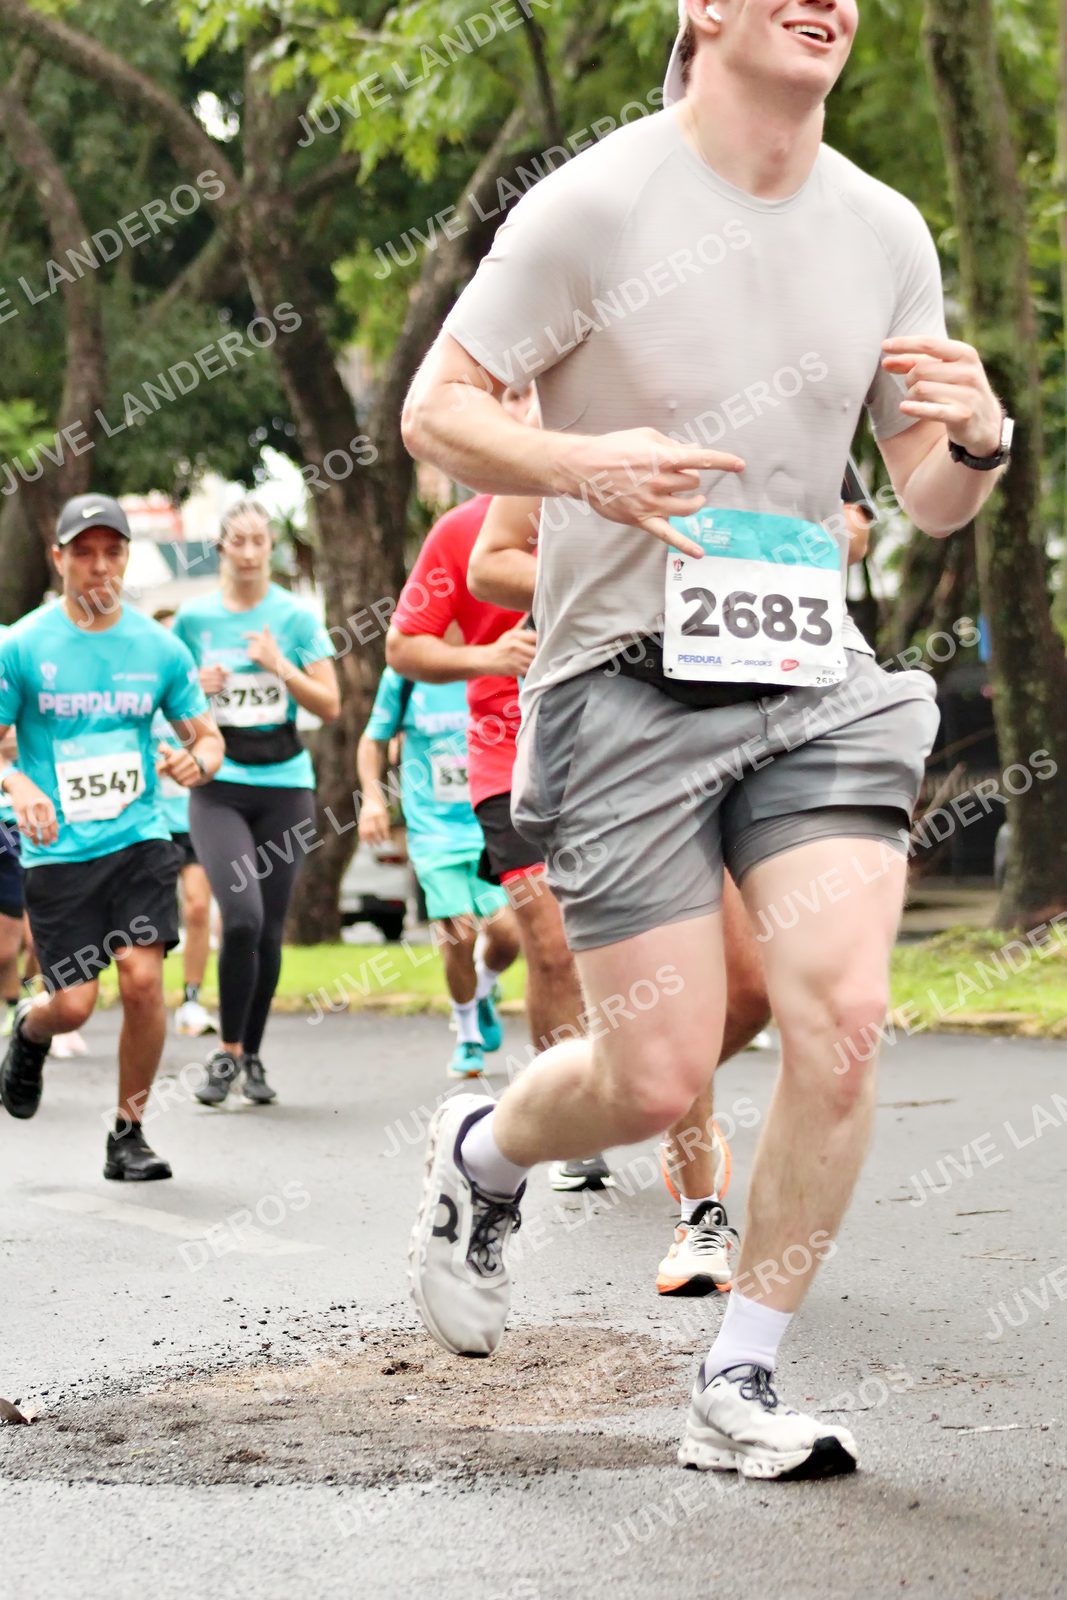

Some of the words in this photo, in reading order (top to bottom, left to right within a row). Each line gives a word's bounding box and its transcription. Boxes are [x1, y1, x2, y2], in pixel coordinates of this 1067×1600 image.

[680, 587, 833, 647] 2683
[678, 654, 722, 665] PERDURA
[38, 690, 153, 717] PERDURA
[66, 769, 140, 801] 3547
